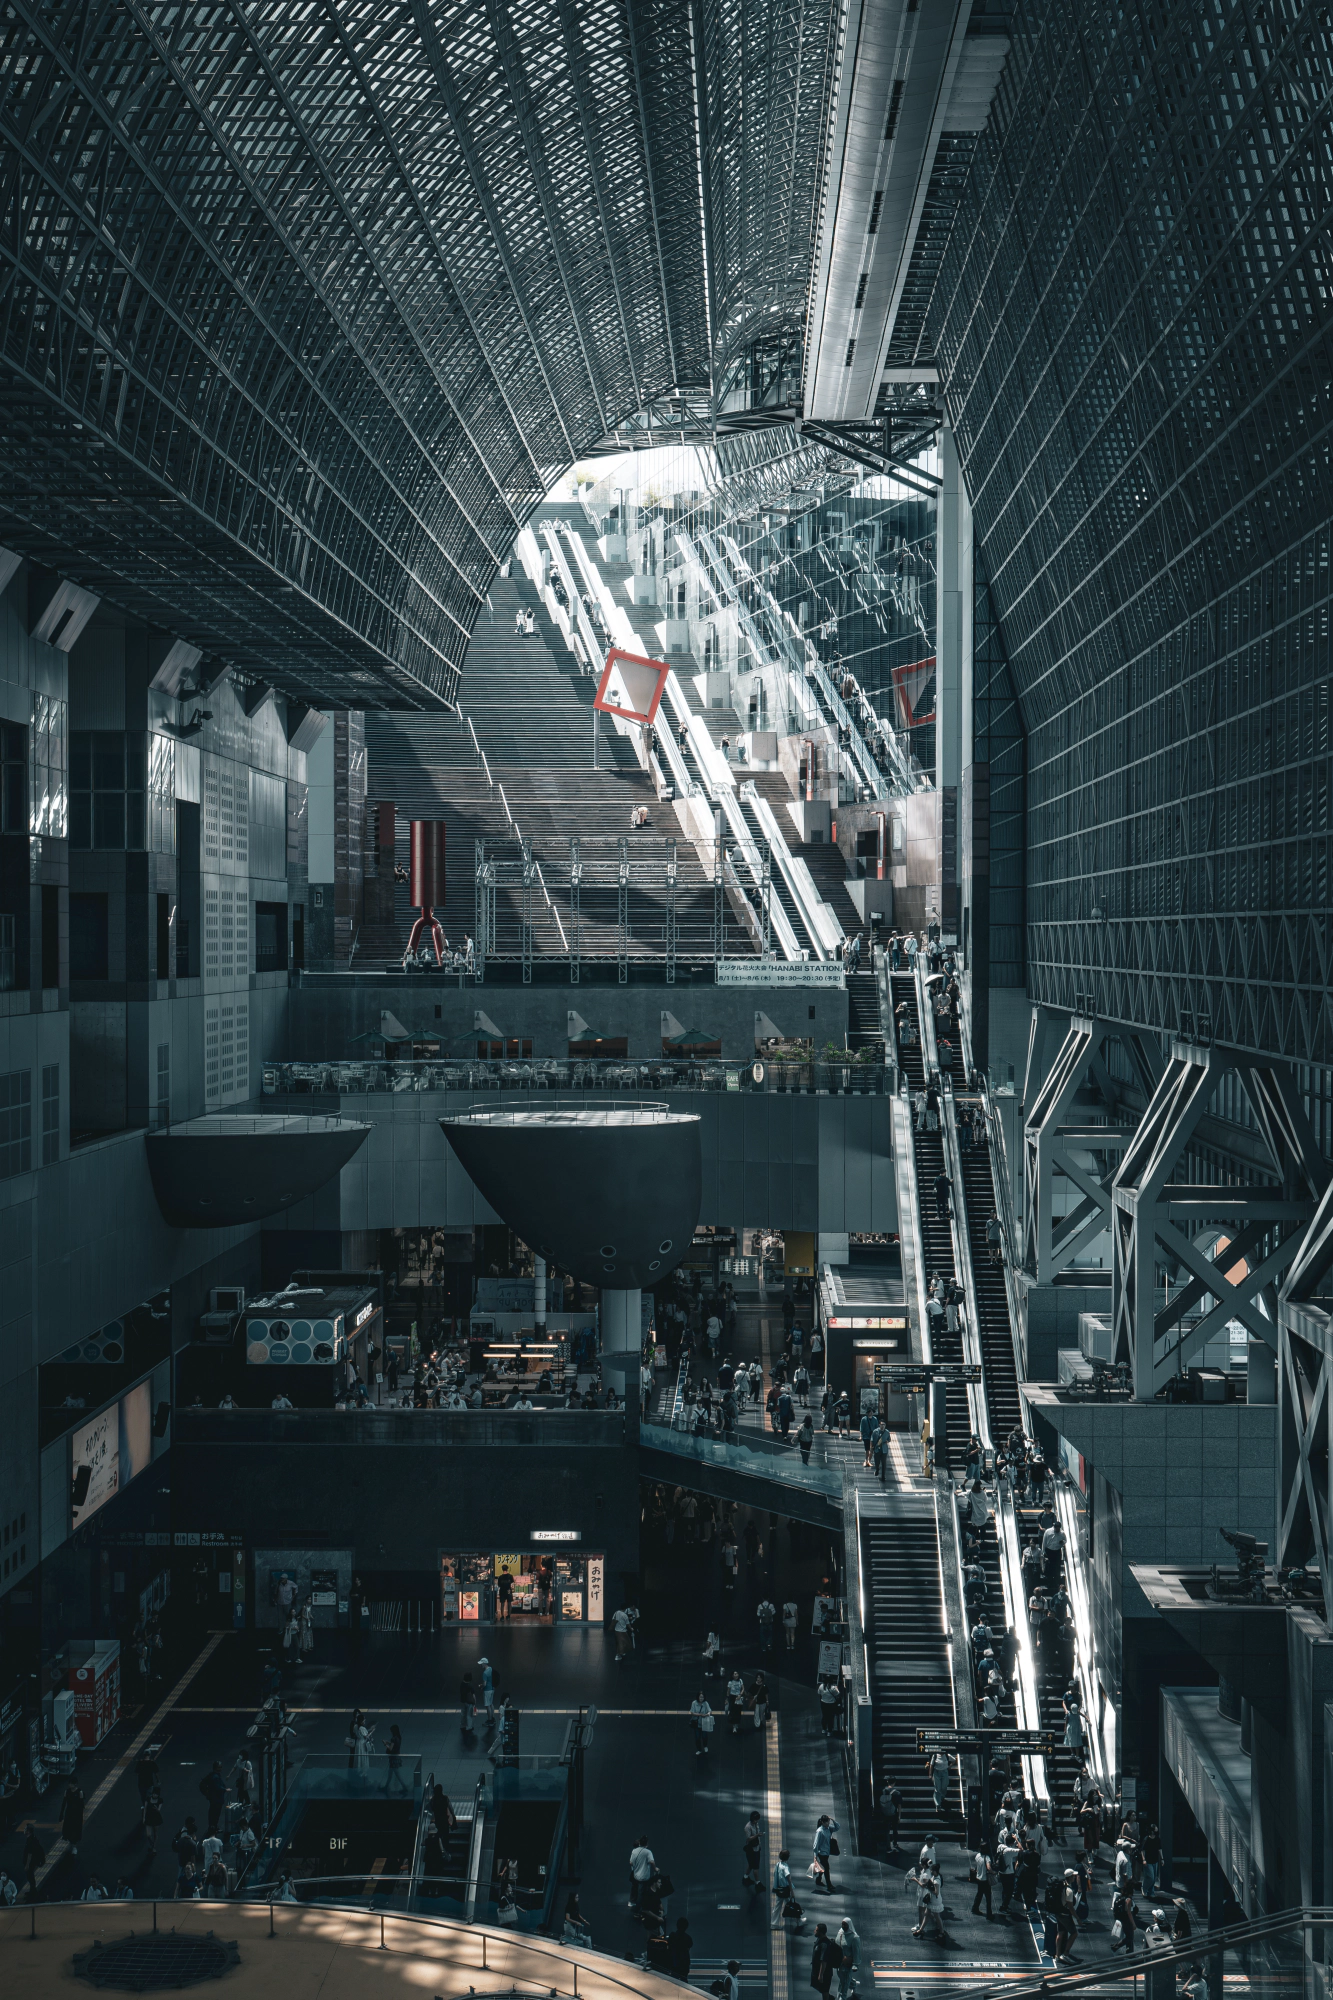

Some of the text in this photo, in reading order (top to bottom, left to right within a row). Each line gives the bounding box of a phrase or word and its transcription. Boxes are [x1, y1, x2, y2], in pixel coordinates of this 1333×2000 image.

[201, 1532, 225, 1540] お手洗
[590, 1566, 602, 1601] おみやげ
[329, 1838, 348, 1850] B1F
